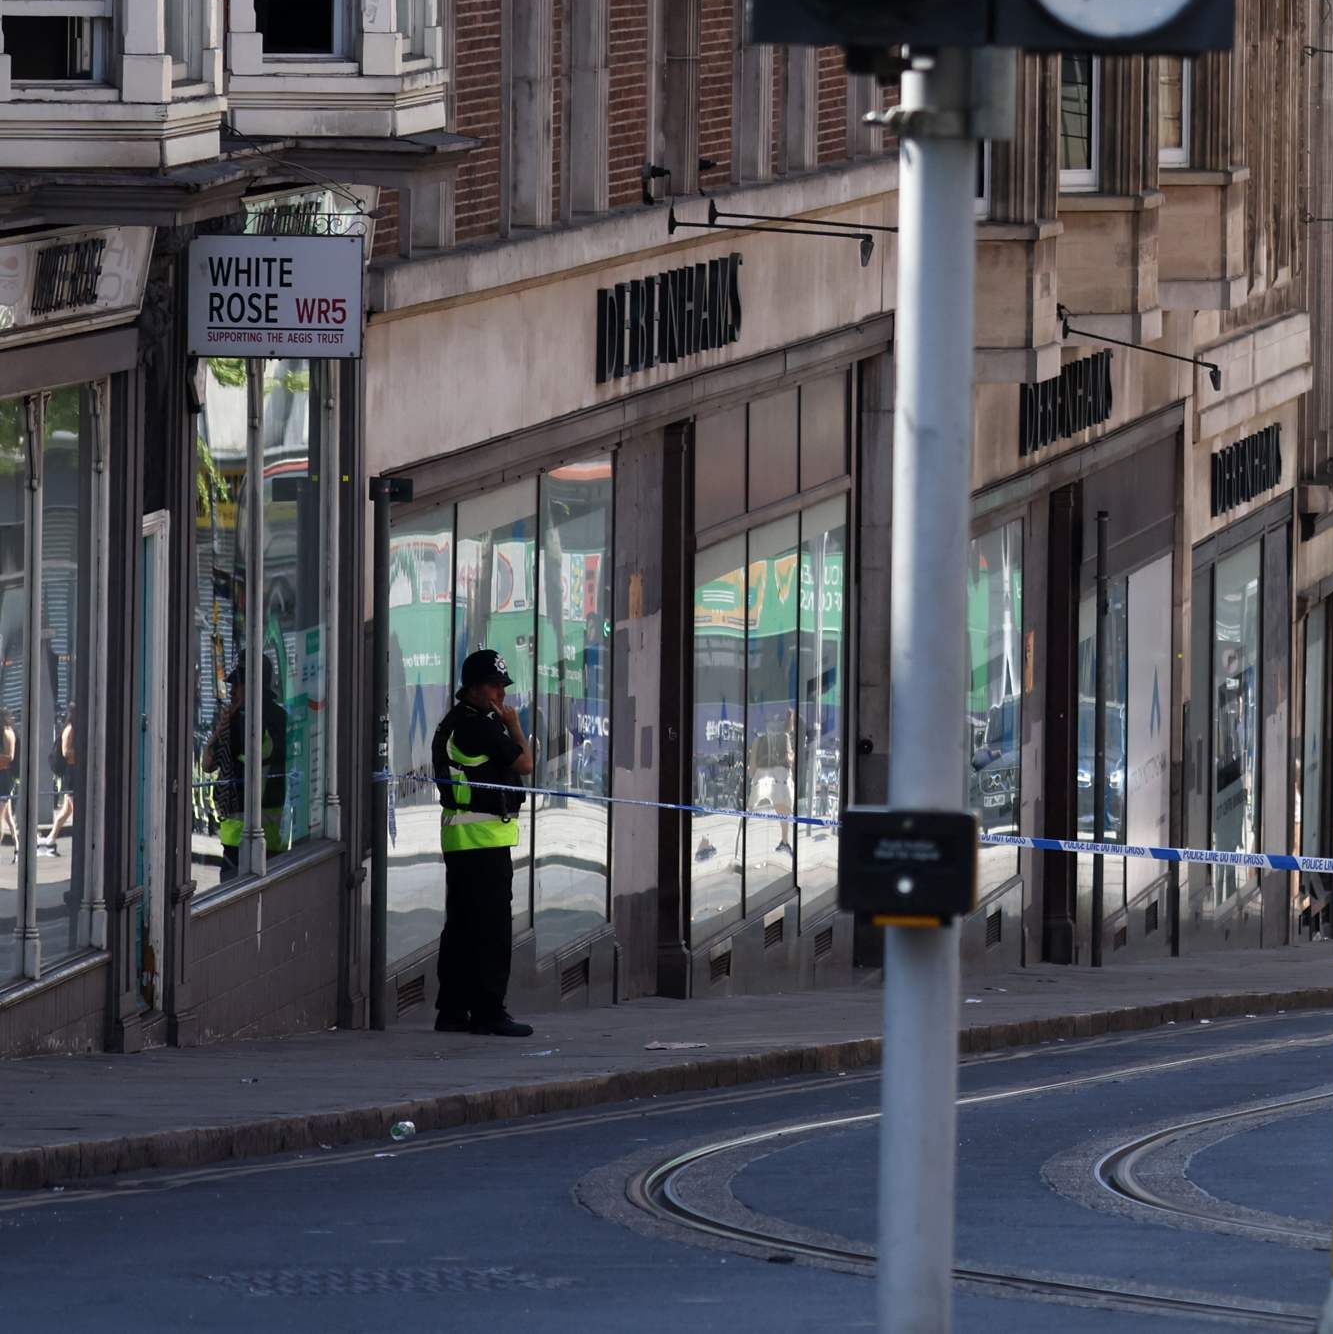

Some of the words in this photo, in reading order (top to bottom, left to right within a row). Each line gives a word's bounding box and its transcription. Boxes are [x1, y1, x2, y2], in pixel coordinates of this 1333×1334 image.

[208, 256, 293, 288] WHITE
[209, 292, 278, 323] ROSE
[295, 298, 347, 324] WR5
[596, 252, 743, 384] DEBENHAMS
[207, 330, 262, 342] SUPPORTING
[267, 332, 283, 343] THE
[287, 333, 313, 344] AEGIS
[317, 333, 344, 344] TRUST
[1182, 850, 1204, 861] POLICE
[1205, 851, 1219, 862] LINE
[1220, 852, 1228, 863] DO
[1230, 853, 1242, 864] NOT
[1243, 854, 1264, 865] CROSS
[1302, 858, 1323, 871] POLICE
